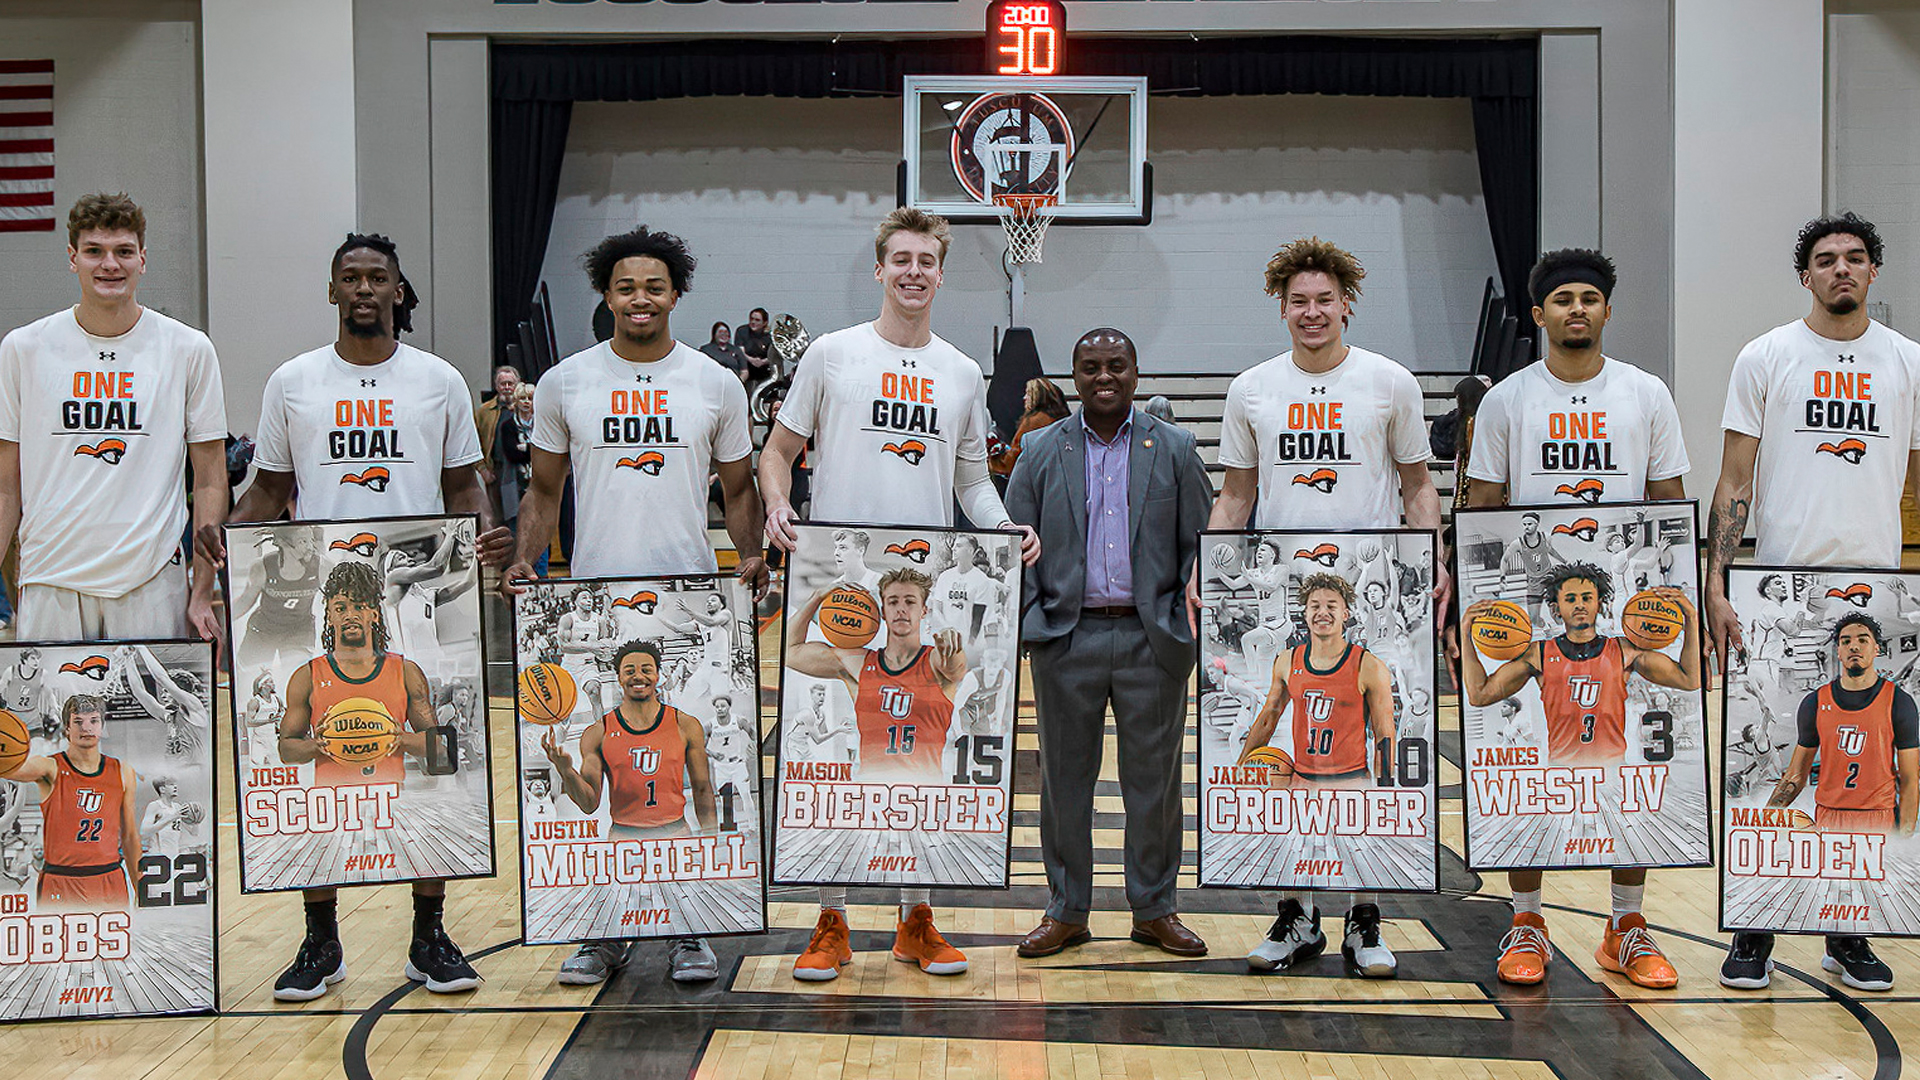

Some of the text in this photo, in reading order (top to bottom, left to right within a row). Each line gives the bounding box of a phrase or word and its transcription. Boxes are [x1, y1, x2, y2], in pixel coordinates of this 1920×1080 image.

[1004, 6, 1049, 25] 20:00
[999, 26, 1055, 74] 30
[73, 371, 134, 399] ONE
[882, 372, 934, 404] ONE
[1814, 370, 1872, 401] ONE
[62, 401, 142, 430] GOAL
[336, 399, 394, 427] ONE
[612, 390, 668, 415] ONE
[1287, 402, 1343, 430] ONE
[1806, 399, 1880, 432] GOAL
[603, 417, 679, 443] GOAL
[872, 399, 940, 435] GOAL
[1549, 412, 1607, 439] ONE
[329, 430, 404, 459] GOAL
[1278, 432, 1351, 460] GOAL
[1541, 442, 1617, 470] GOAL
[831, 592, 871, 613] Wilson
[1638, 600, 1678, 618] Wilson
[831, 613, 862, 629] NCAA
[1479, 627, 1508, 640] NCAA
[1640, 620, 1670, 635] NCAA
[530, 665, 553, 702] Wilson
[1568, 675, 1602, 708] TU
[18, 697, 30, 706] 22
[879, 685, 914, 719] TU
[1303, 689, 1335, 722] TU
[334, 720, 384, 733] Wilson
[885, 725, 916, 755] 15
[1580, 713, 1596, 743] 3
[1642, 711, 1676, 762] 3
[1838, 724, 1867, 757] TU
[342, 742, 379, 755] NCAA
[1307, 728, 1334, 756] 10
[629, 746, 661, 775] TU
[952, 735, 1004, 785] 15
[1376, 737, 1428, 787] 10
[1472, 747, 1538, 766] JAMES
[247, 766, 299, 787] JOSH
[786, 761, 852, 781] MASON
[1208, 765, 1269, 786] JALEN
[1844, 763, 1860, 789] 2
[77, 788, 104, 814] TU
[645, 780, 657, 807] 1
[1471, 764, 1668, 816] WEST IV
[245, 782, 399, 837] SCOTT
[718, 782, 738, 832] 1
[782, 782, 1005, 833] BIERSTER
[1206, 787, 1427, 837] CROWDER
[1731, 808, 1794, 828] MAKAI
[76, 818, 103, 842] 22
[530, 819, 600, 841] JUSTIN
[1564, 838, 1615, 854] #WY1
[1729, 829, 1885, 881] OLDEN
[344, 853, 396, 872] #WY1
[528, 835, 758, 889] MITCHELL
[867, 856, 917, 872] #WY1
[1294, 859, 1344, 876] #WY1
[138, 853, 207, 907] 22
[620, 909, 671, 926] #WY1
[1818, 904, 1870, 921] #WY1
[59, 986, 114, 1004] #WY1
